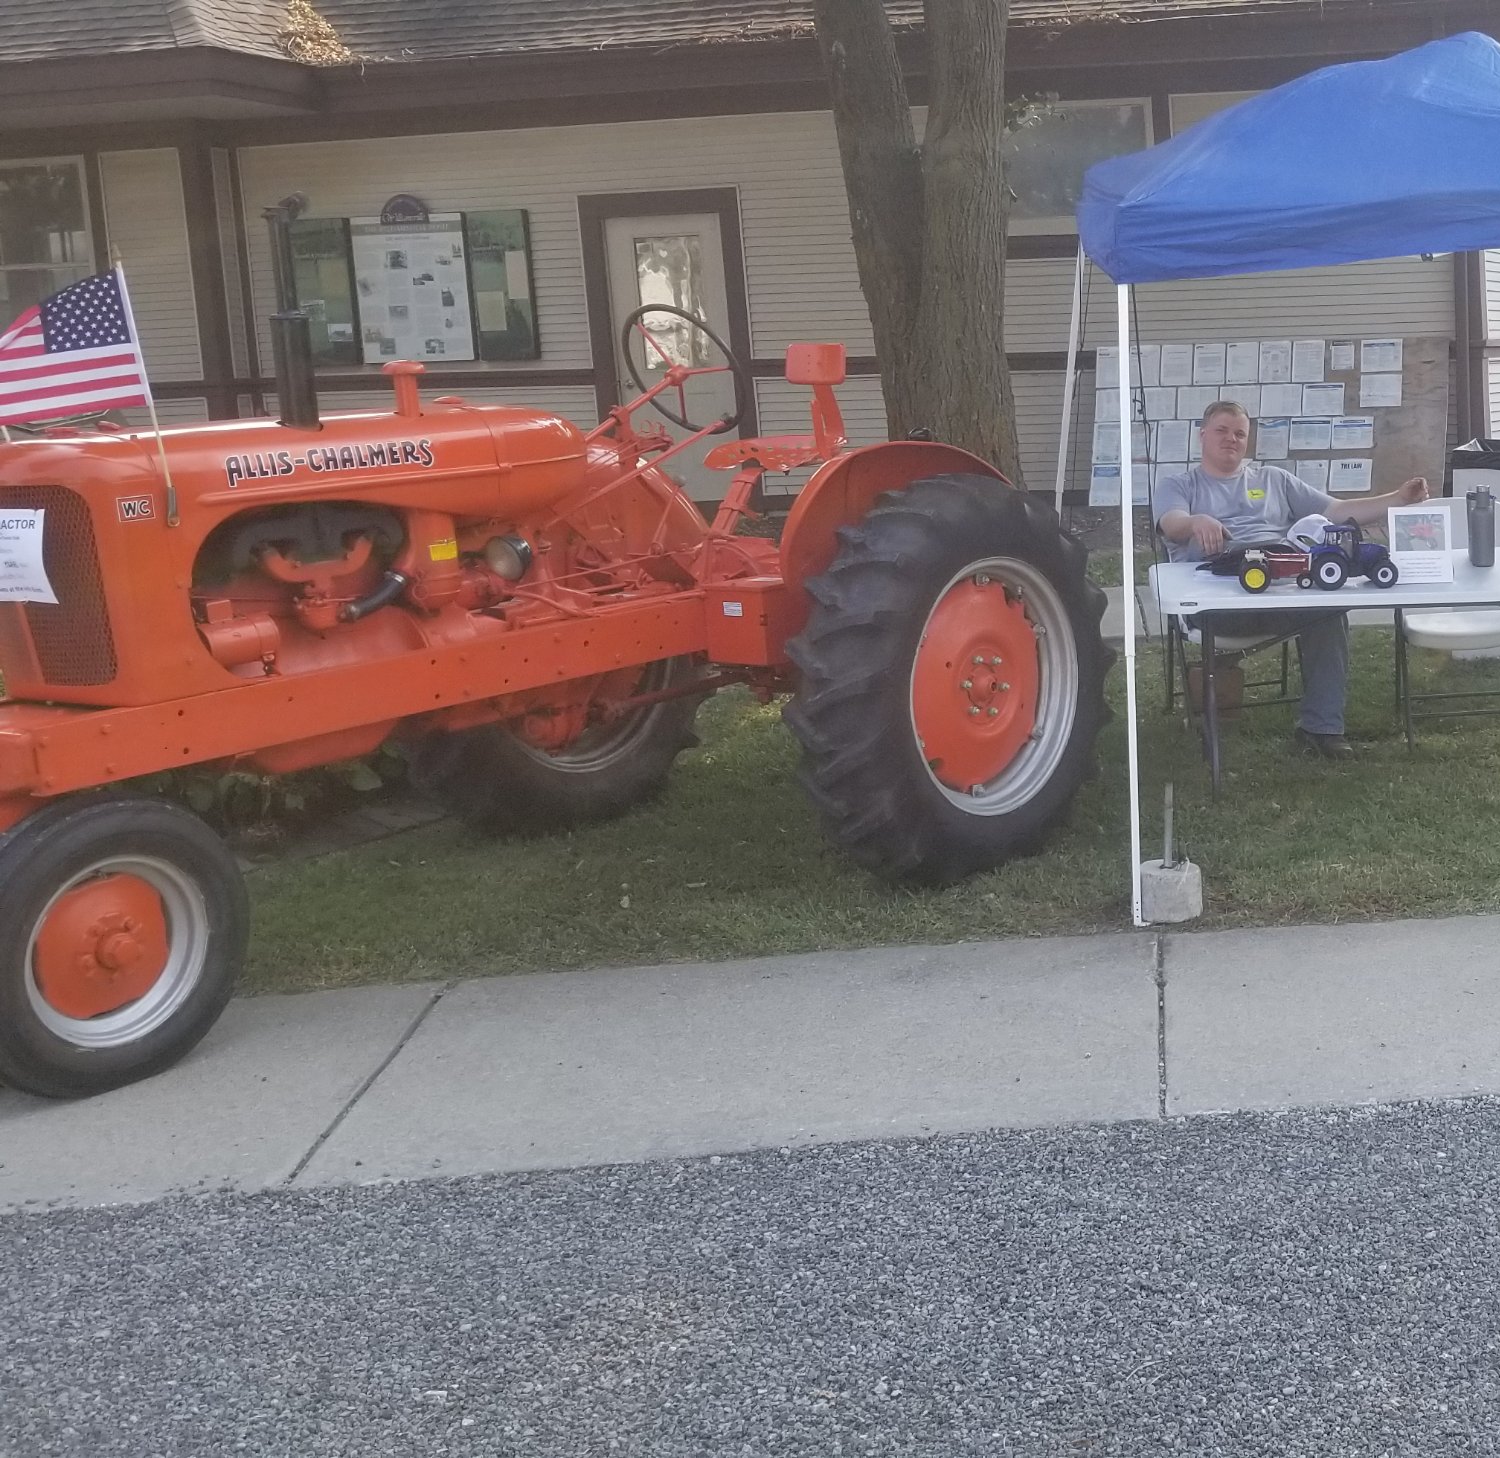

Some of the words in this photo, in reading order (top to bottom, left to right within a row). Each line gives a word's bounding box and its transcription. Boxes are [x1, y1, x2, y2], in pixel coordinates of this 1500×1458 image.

[225, 439, 434, 487] ALLIS-CHALMERS
[121, 500, 150, 518] WC
[0, 519, 36, 530] ACTOR
